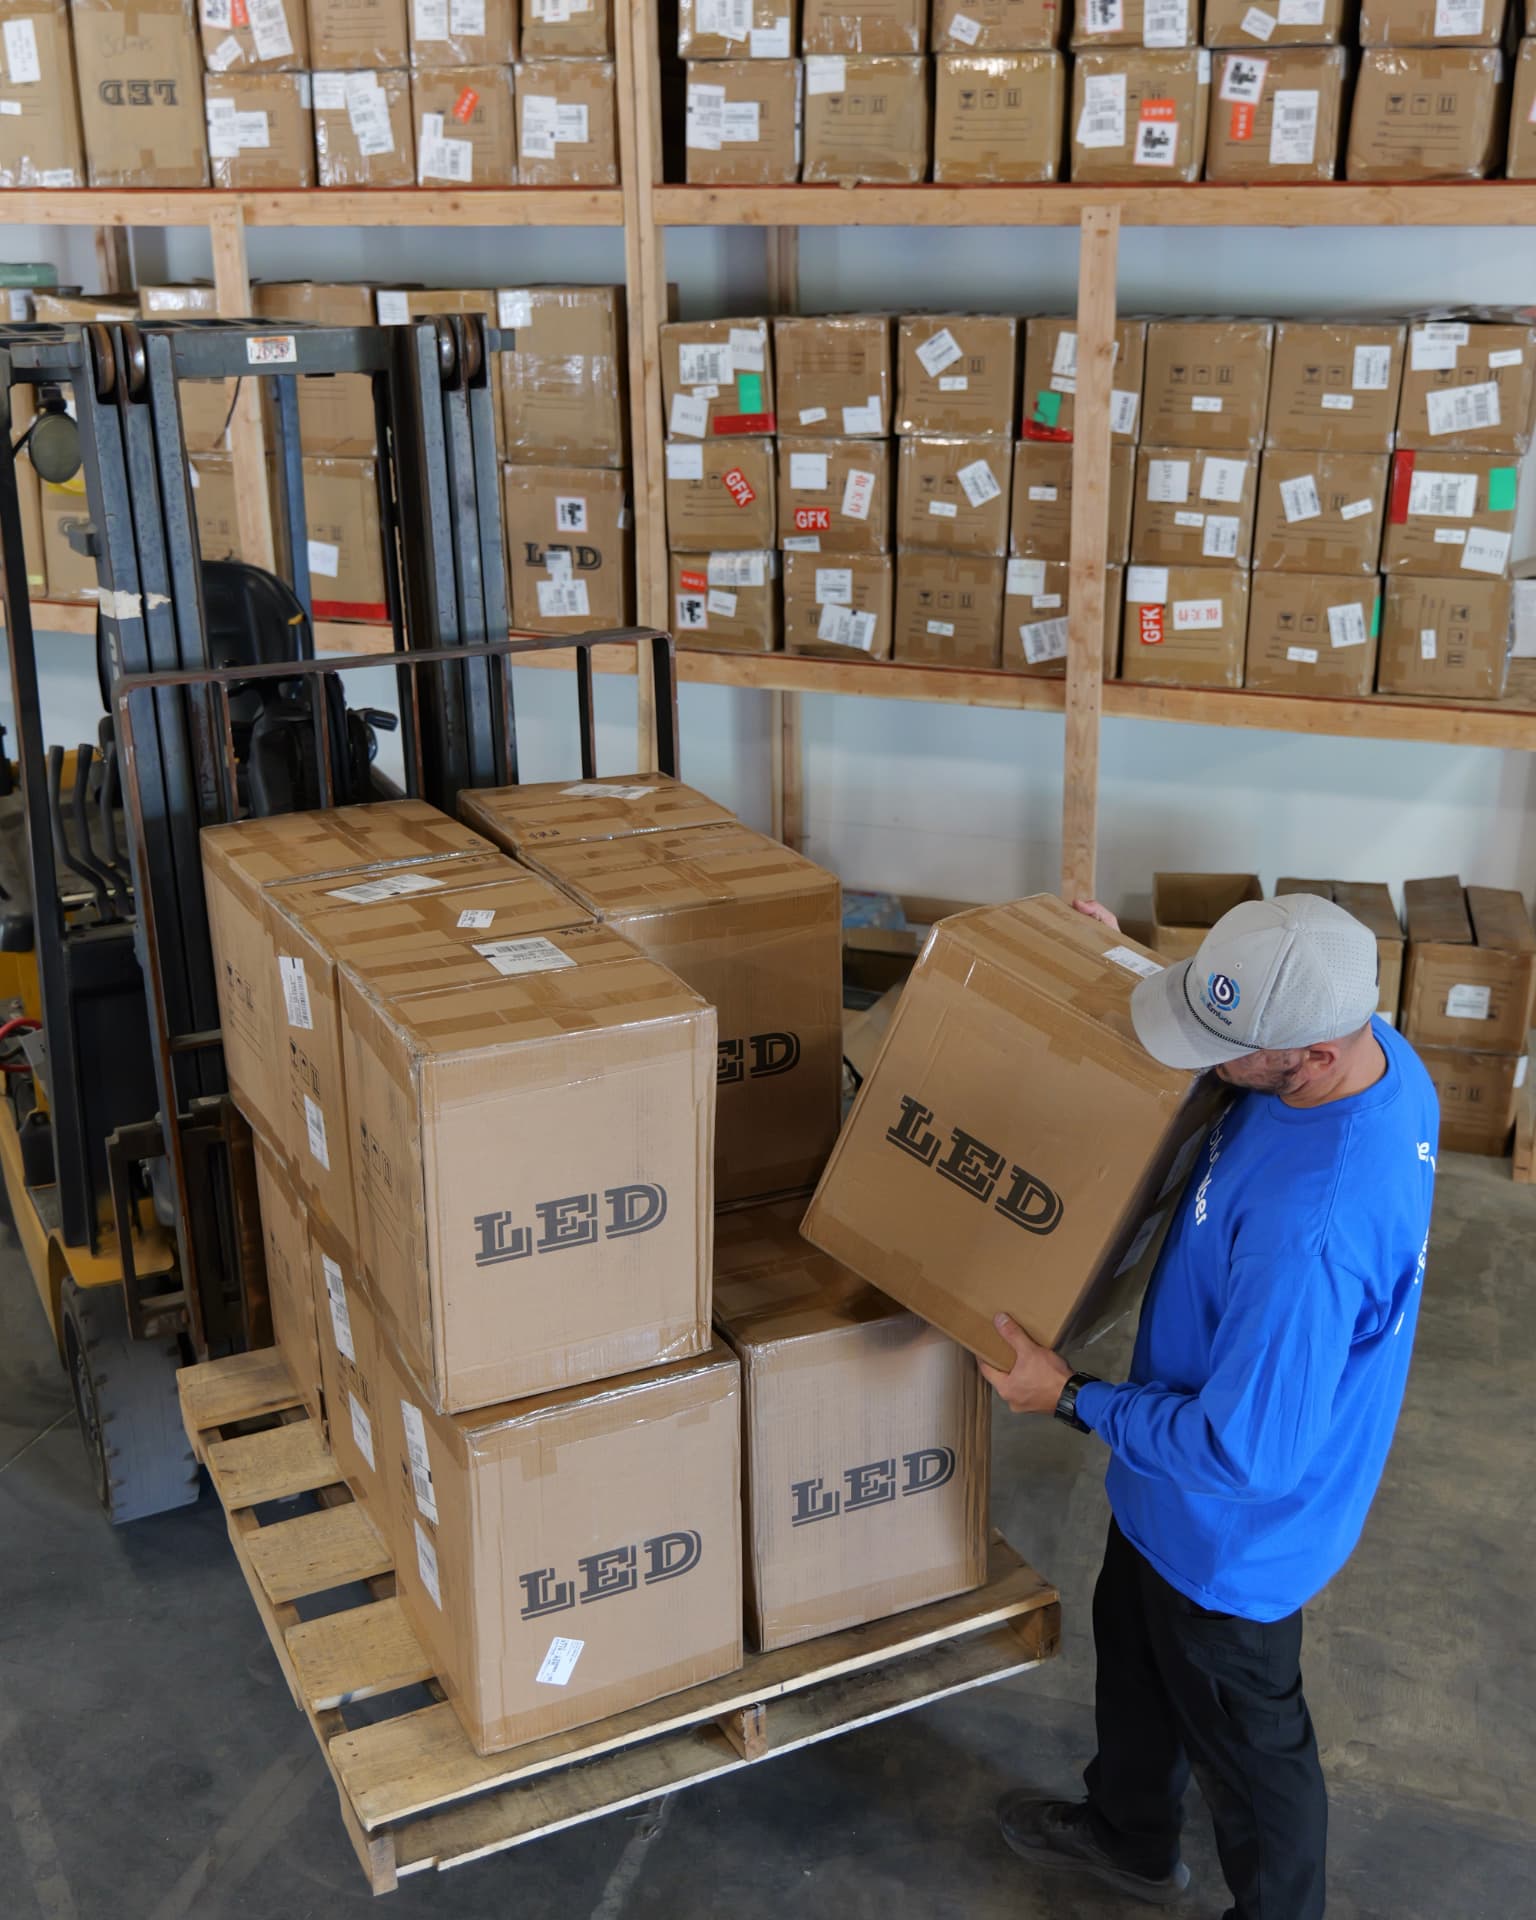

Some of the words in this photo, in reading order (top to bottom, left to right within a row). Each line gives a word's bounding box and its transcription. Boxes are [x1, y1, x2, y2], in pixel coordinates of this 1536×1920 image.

[99, 79, 178, 106] LED
[724, 471, 754, 506] GFK
[796, 511, 829, 529] GFK
[1142, 607, 1162, 643] GFK
[717, 1031, 801, 1085] ED
[885, 1094, 1065, 1236] LED
[474, 1183, 668, 1268] LED
[791, 1446, 956, 1528] LED
[519, 1529, 702, 1621] LED
